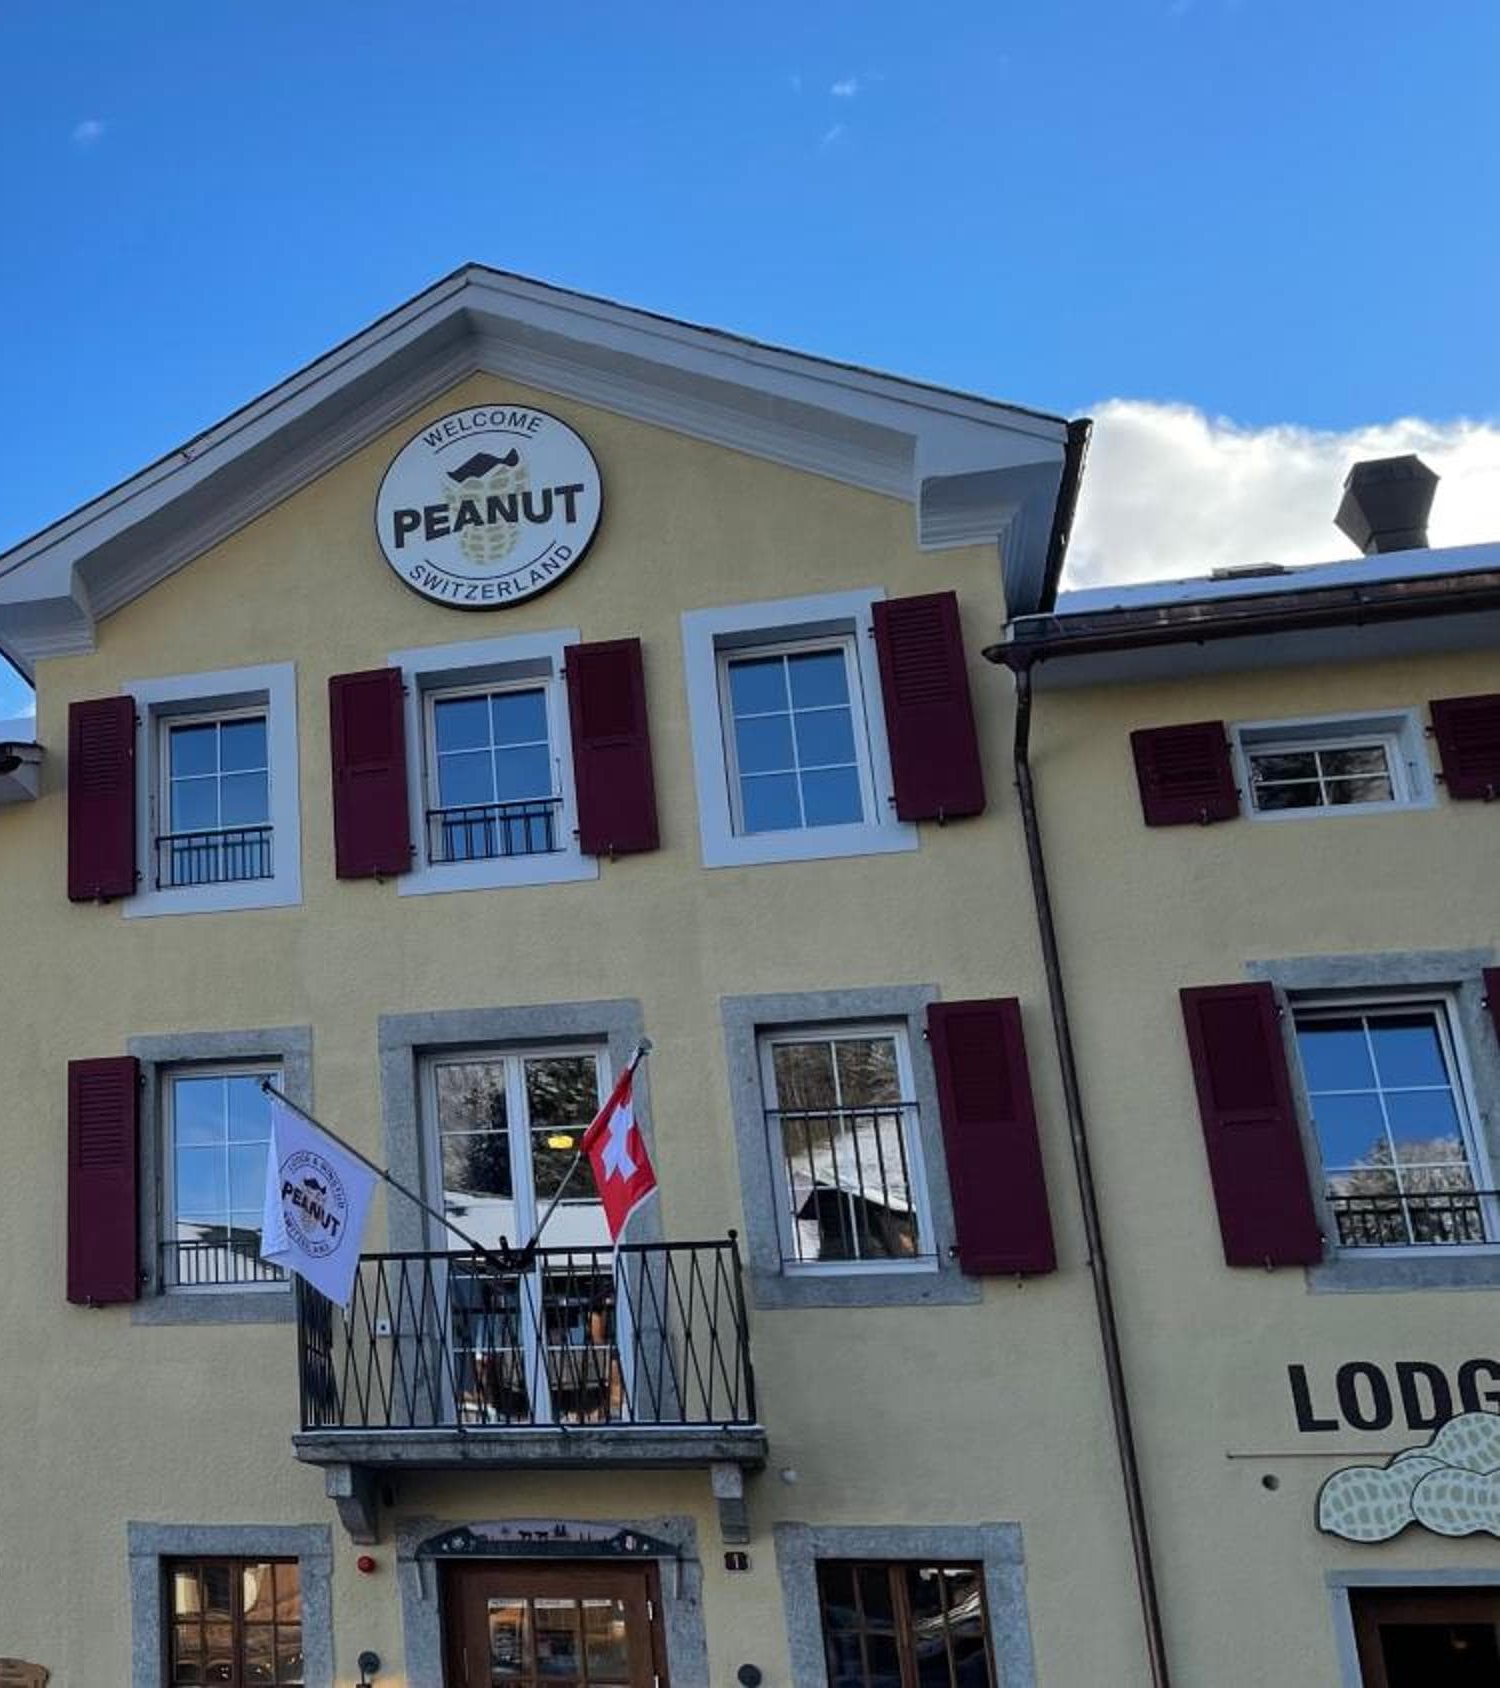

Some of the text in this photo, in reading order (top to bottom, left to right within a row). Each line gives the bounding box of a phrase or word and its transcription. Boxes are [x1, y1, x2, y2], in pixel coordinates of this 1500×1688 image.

[423, 411, 544, 447] WELCOME
[393, 483, 585, 549] PEANUT
[409, 544, 573, 600] SWITZERLAND
[282, 1181, 340, 1237] PEANUT
